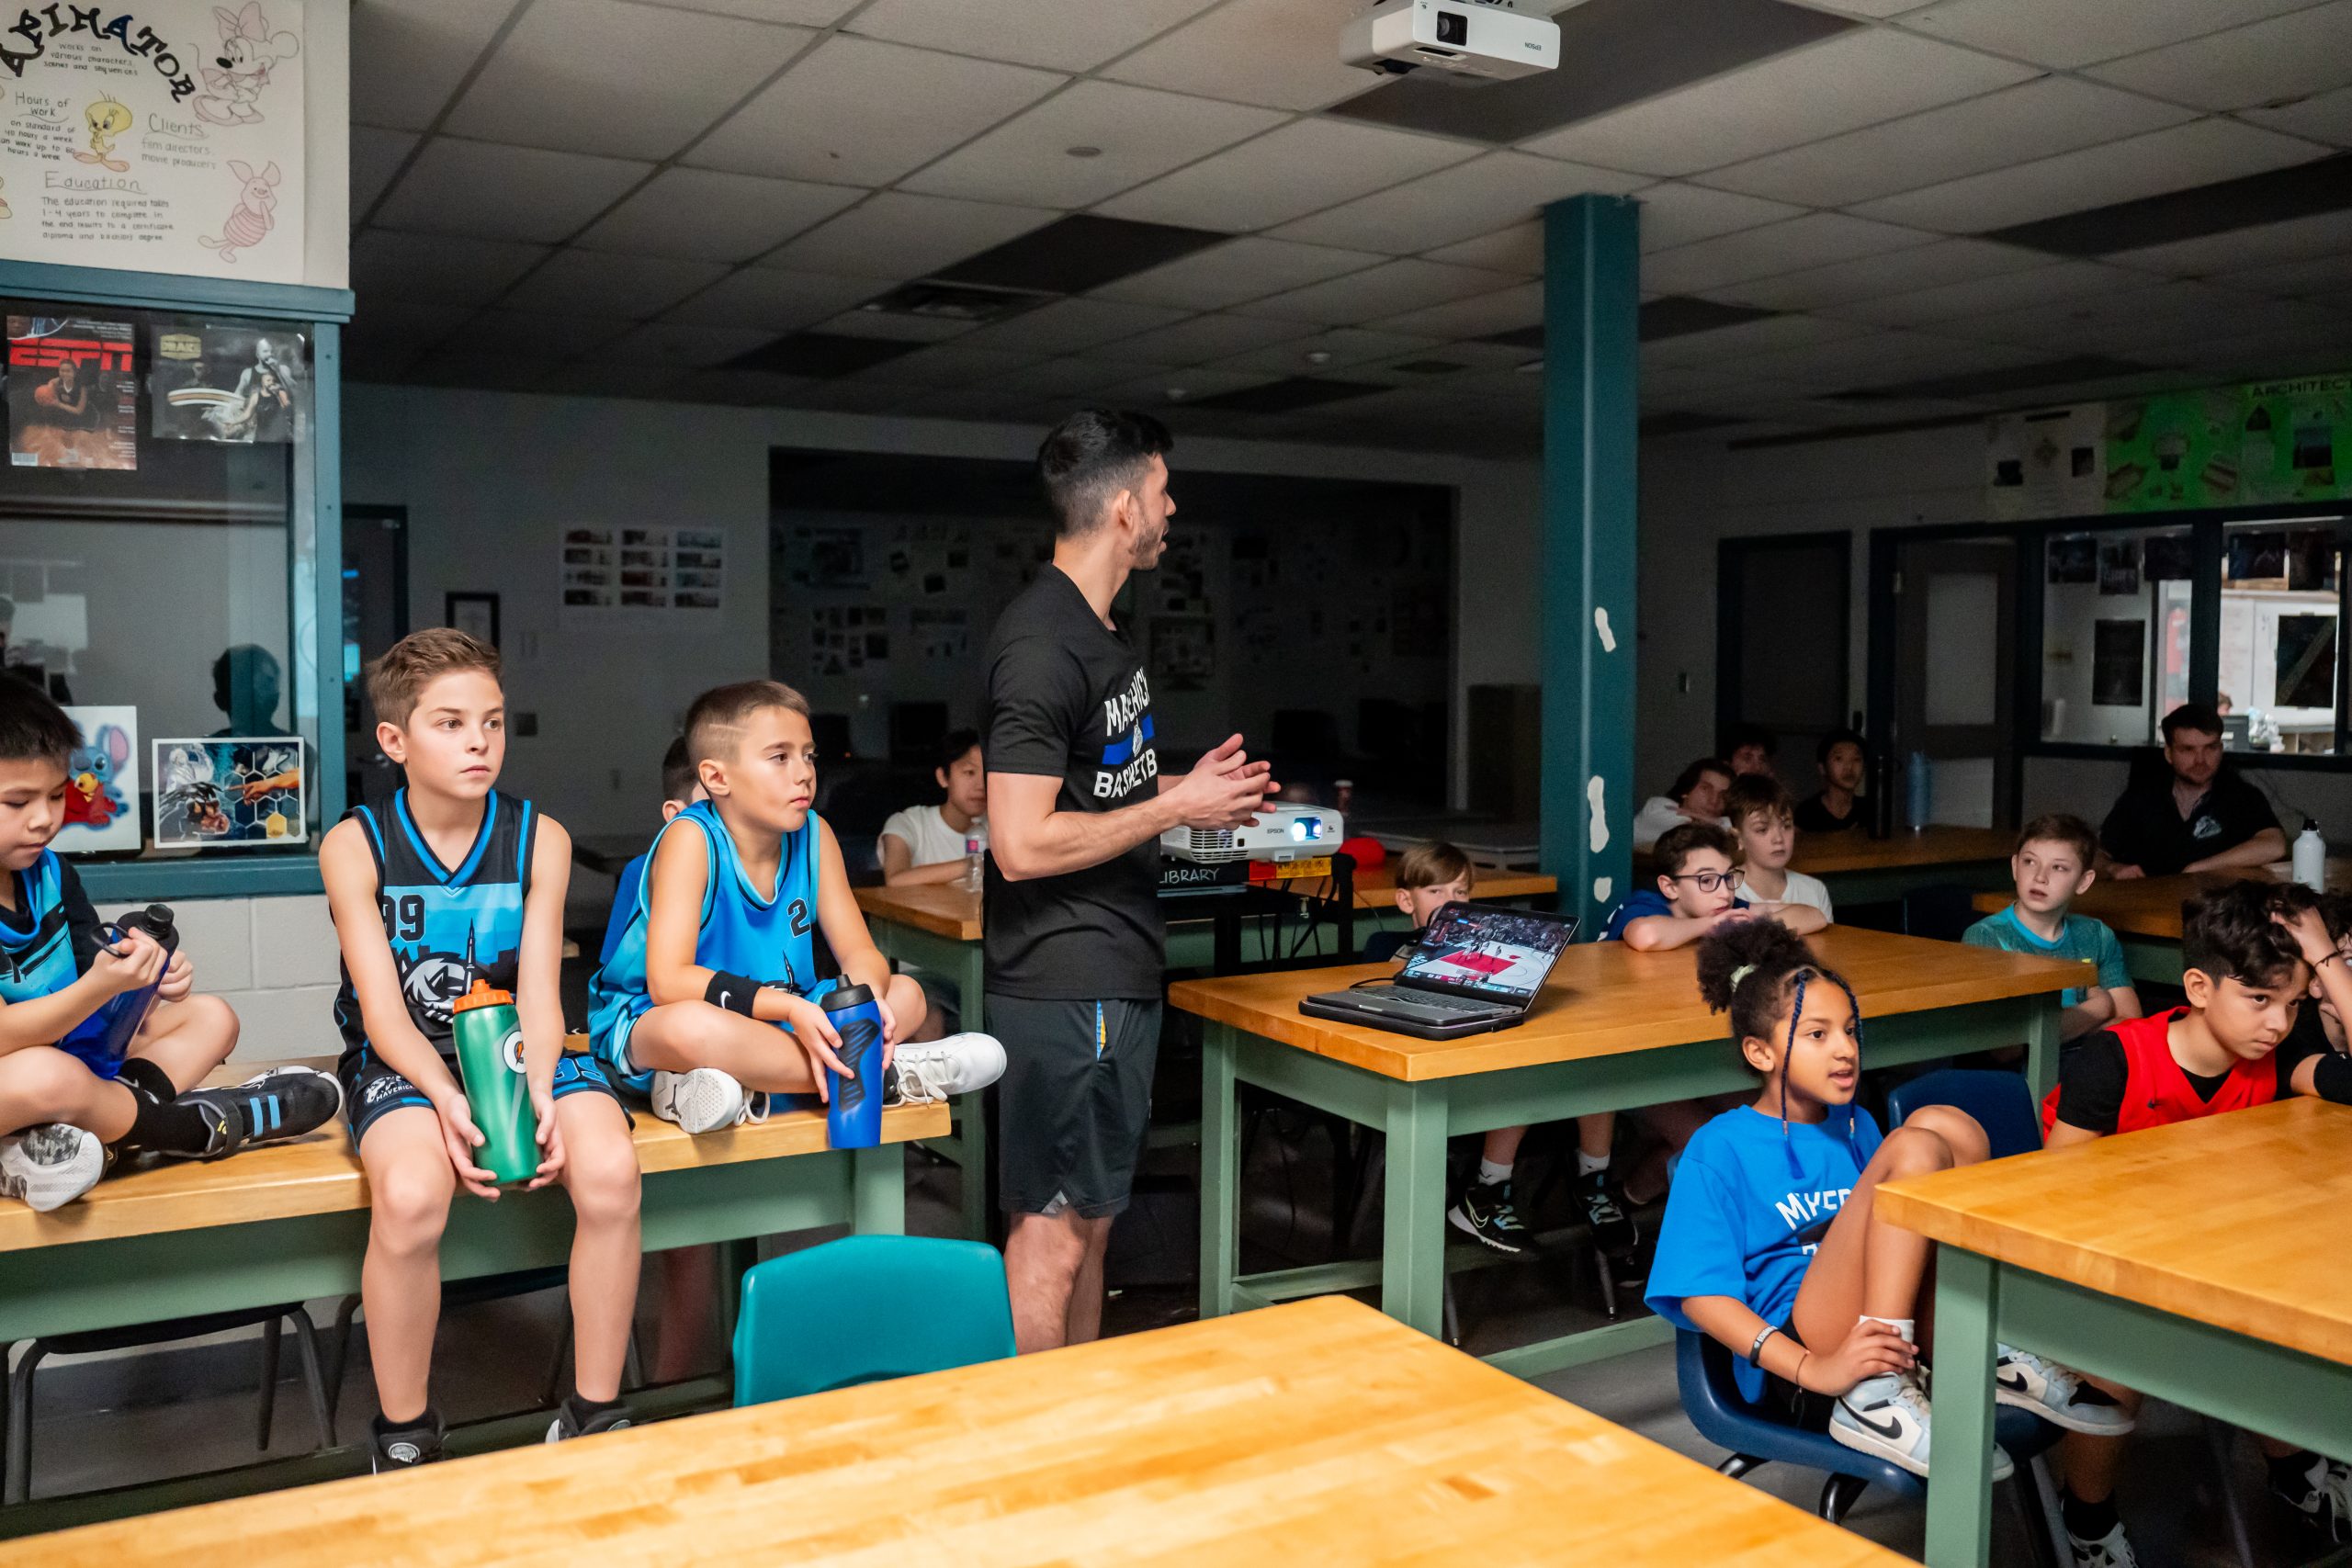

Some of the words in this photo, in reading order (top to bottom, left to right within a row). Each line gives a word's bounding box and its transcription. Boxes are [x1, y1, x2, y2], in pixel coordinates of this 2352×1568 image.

[15, 91, 50, 107] Hours
[57, 97, 71, 108] of
[148, 112, 205, 138] Clients
[45, 170, 141, 191] Education
[41, 196, 59, 206] The
[9, 337, 133, 372] ESPN
[2253, 377, 2352, 398] ARCHITEC
